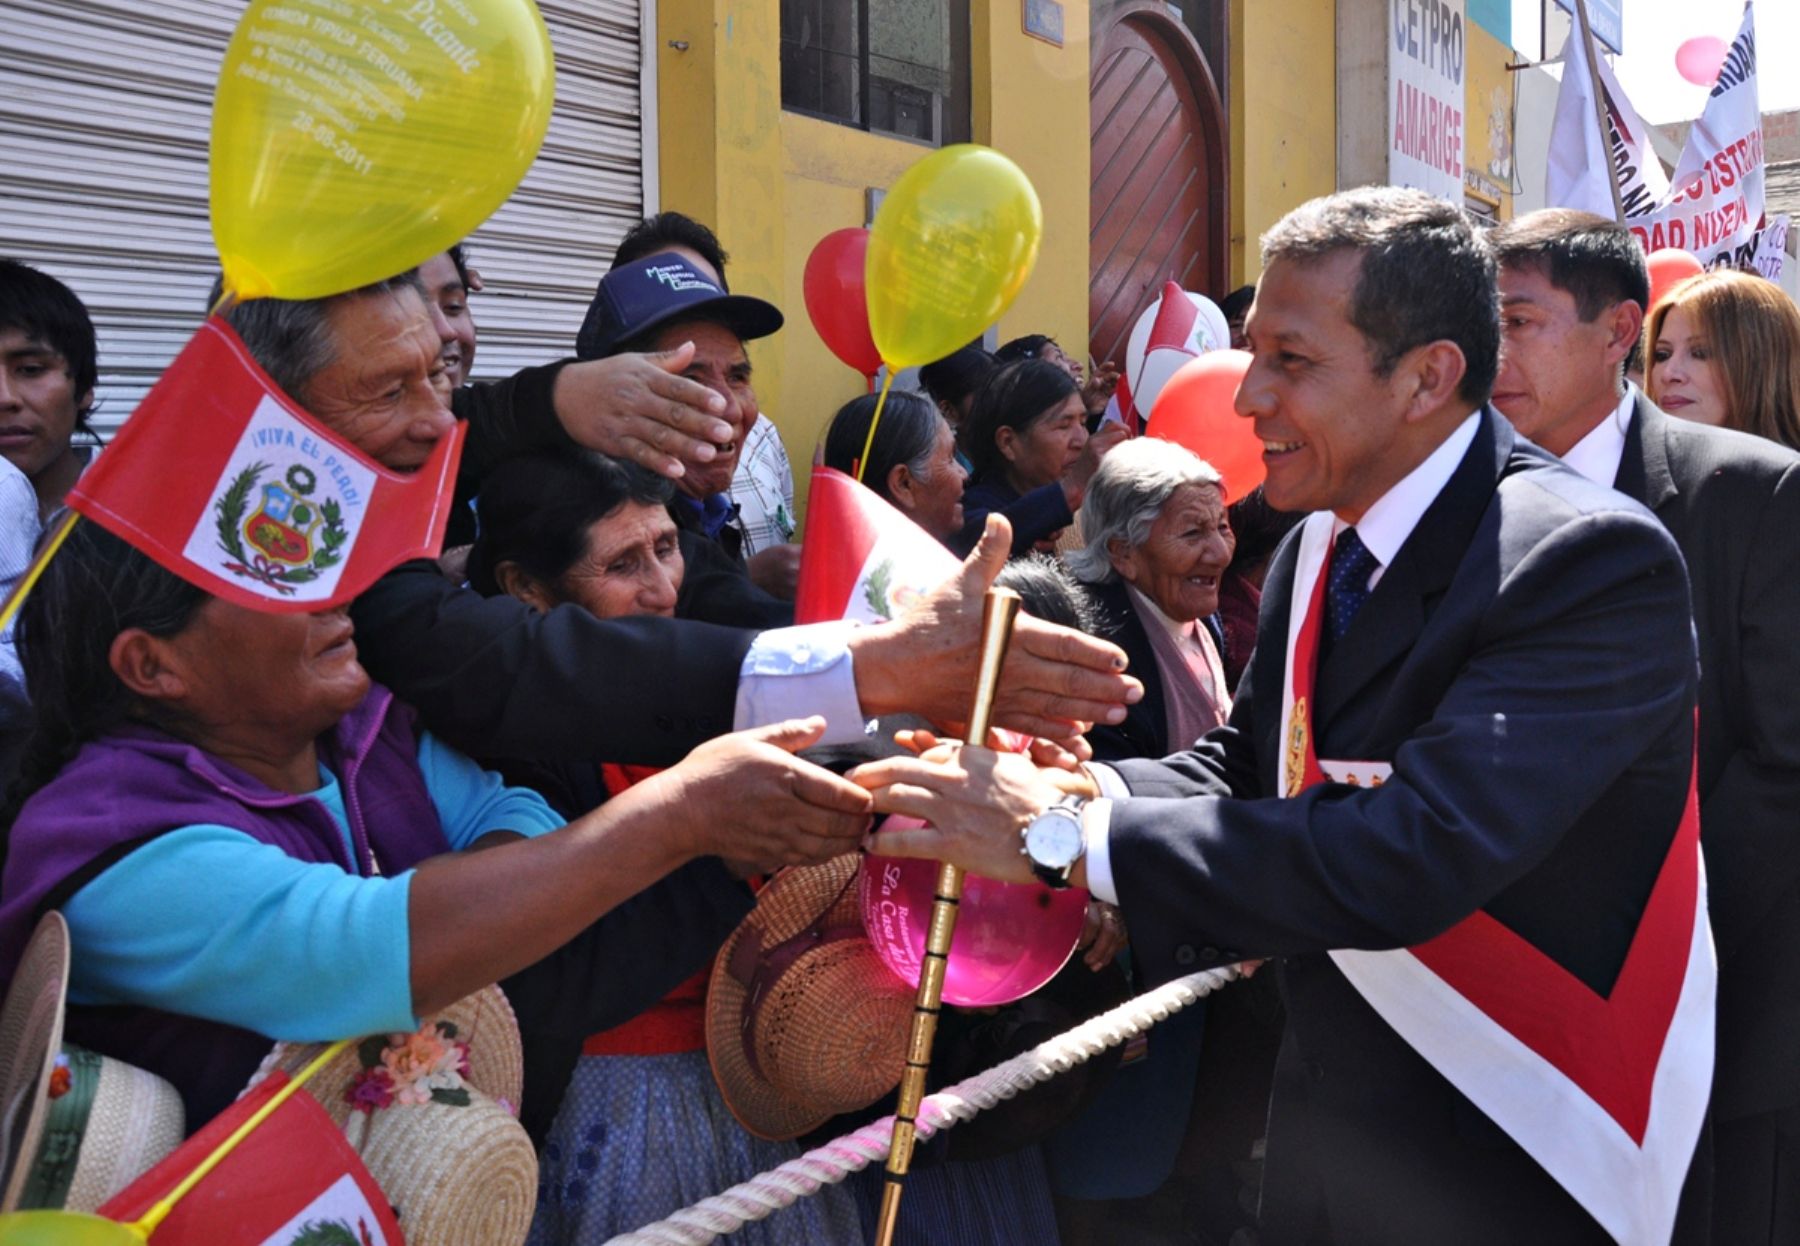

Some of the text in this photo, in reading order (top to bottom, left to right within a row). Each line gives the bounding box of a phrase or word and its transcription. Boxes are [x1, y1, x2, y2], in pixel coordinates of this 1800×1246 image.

[1395, 0, 1463, 86] CETPRO
[1394, 78, 1461, 178] AMARIGE
[301, 436, 320, 460] EL
